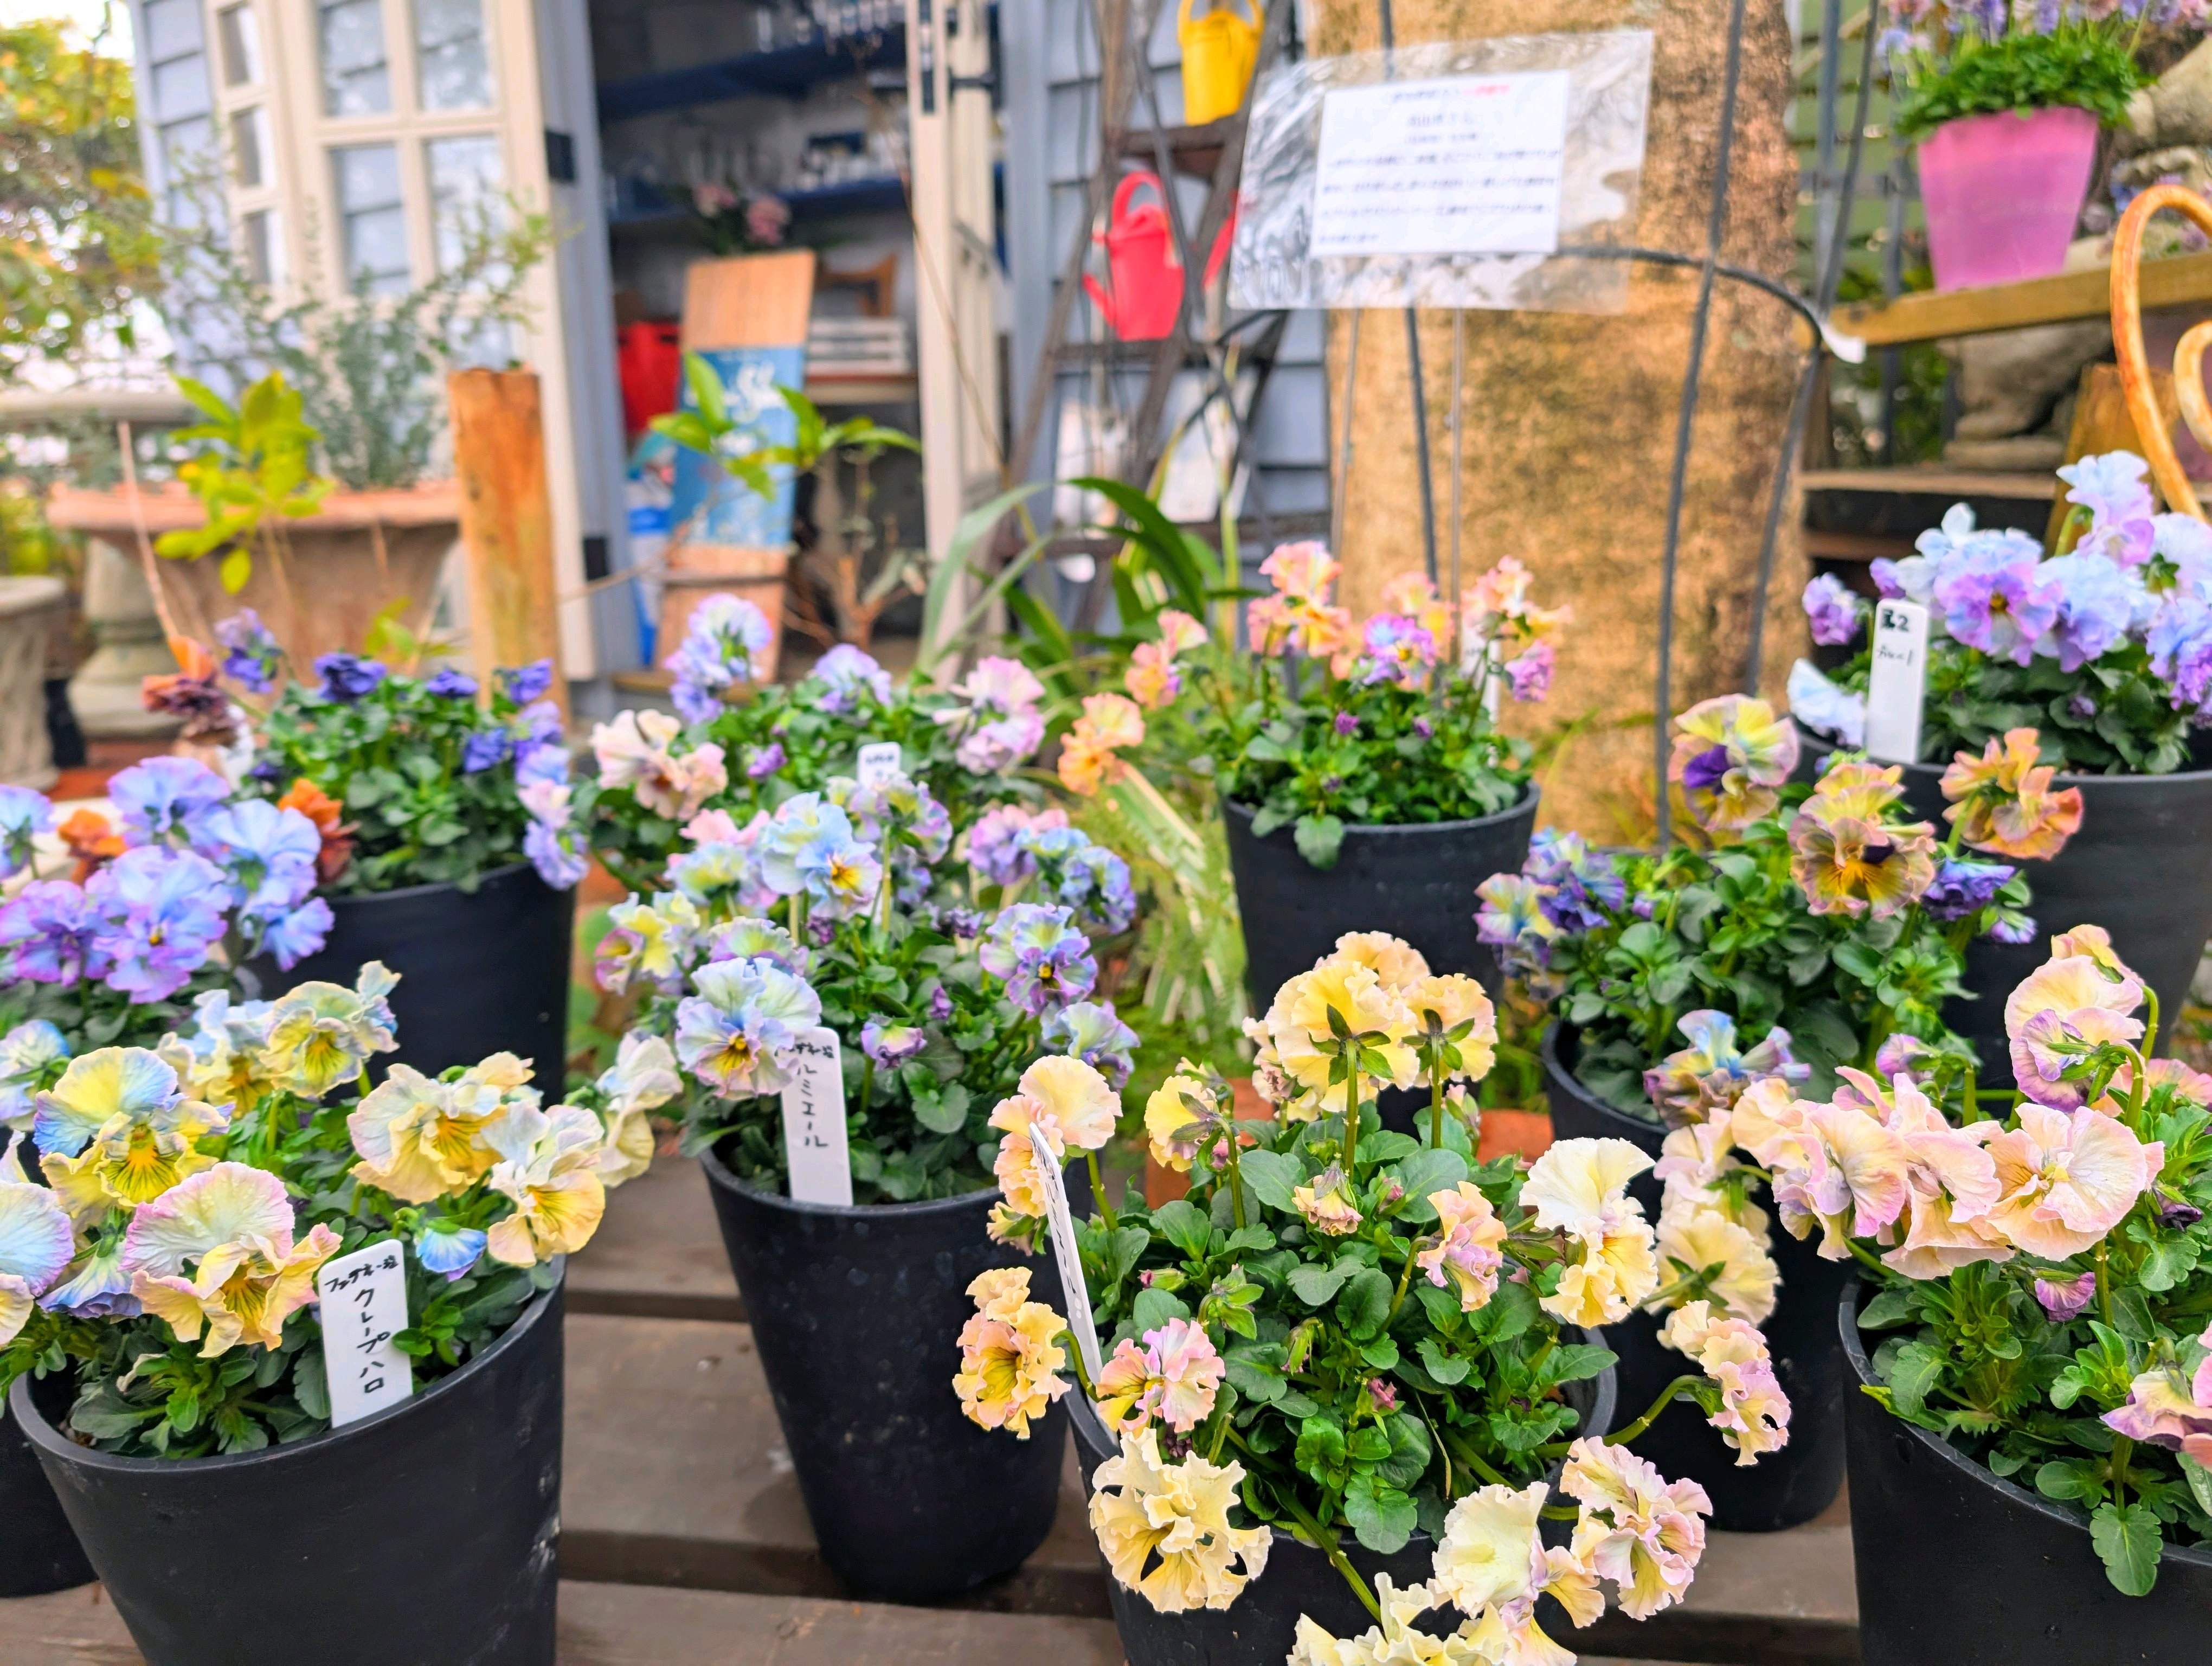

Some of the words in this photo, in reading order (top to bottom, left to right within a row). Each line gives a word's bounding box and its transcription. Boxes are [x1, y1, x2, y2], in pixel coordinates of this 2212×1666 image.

[797, 1063, 829, 1147] ルミエール
[354, 1287, 391, 1394] クレープハロ
